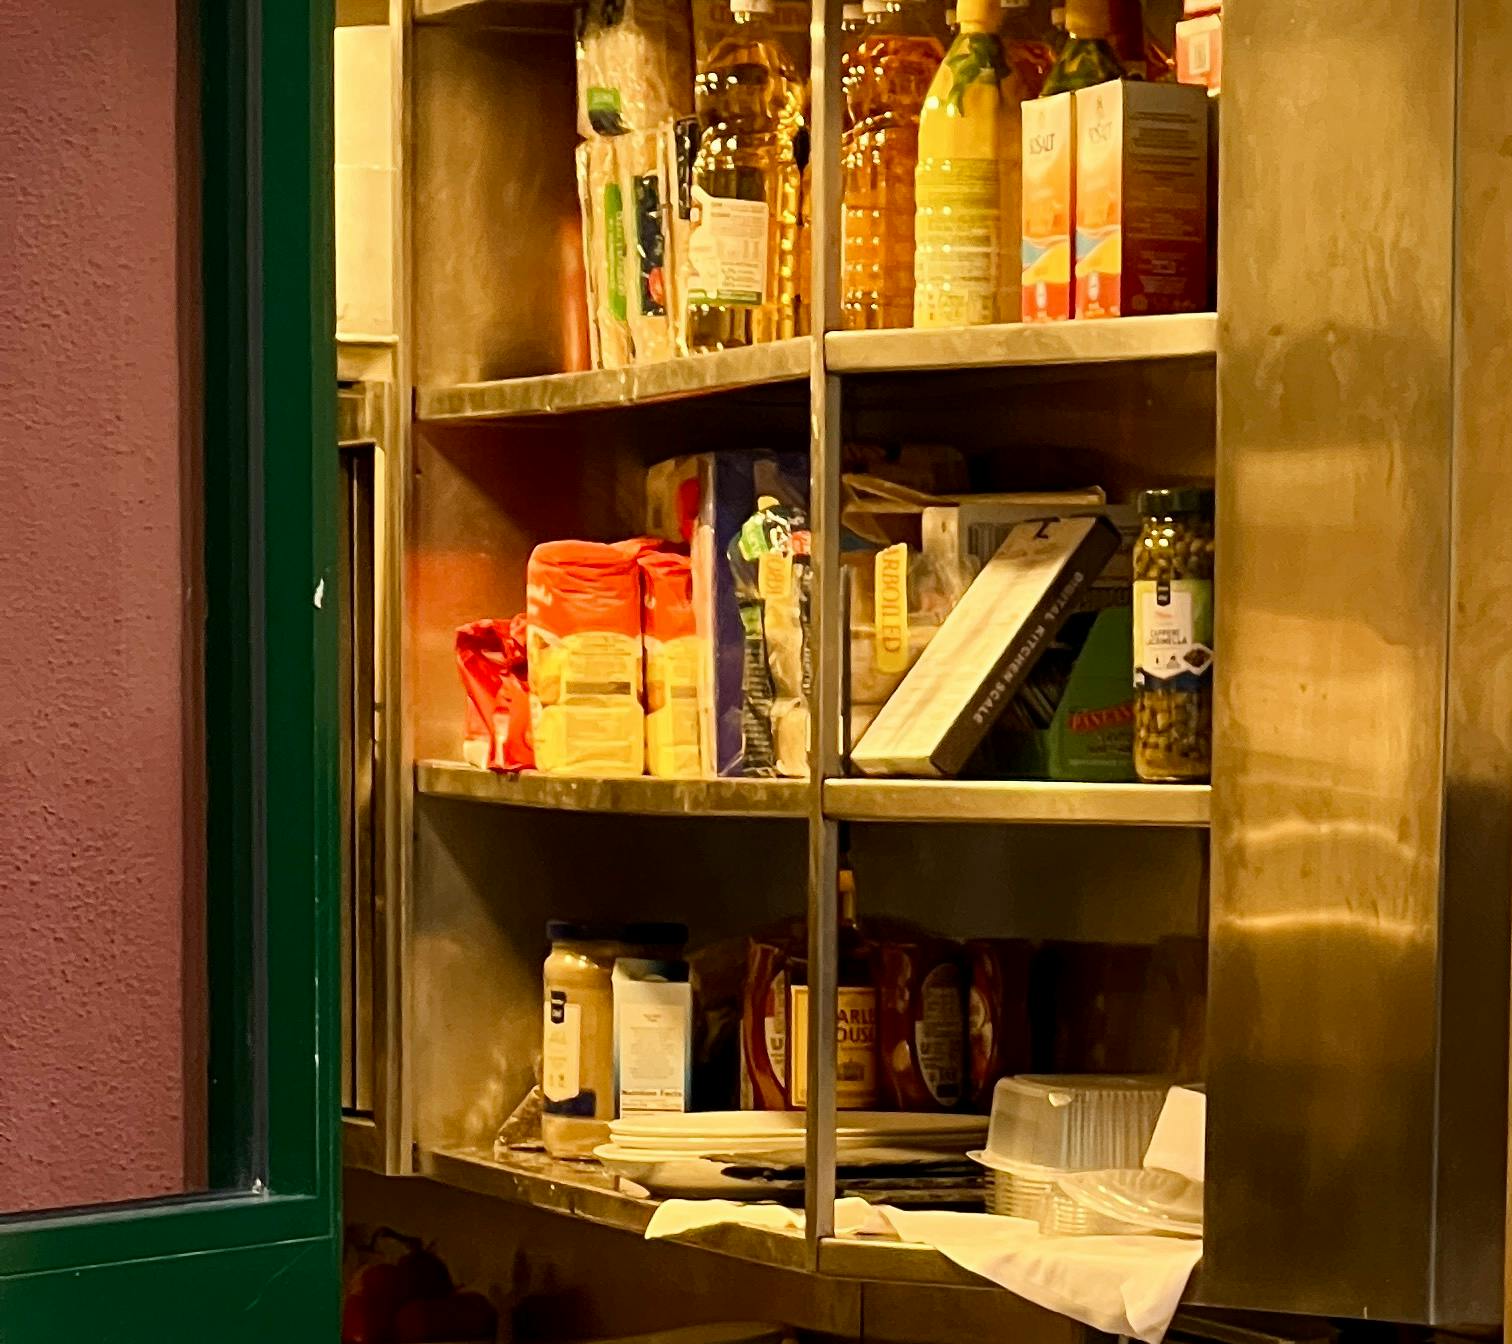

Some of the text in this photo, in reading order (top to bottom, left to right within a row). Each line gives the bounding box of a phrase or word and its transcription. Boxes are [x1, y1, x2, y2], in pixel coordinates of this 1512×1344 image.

[972, 571, 1085, 724] DIGITAL KITCHEN SCALE
